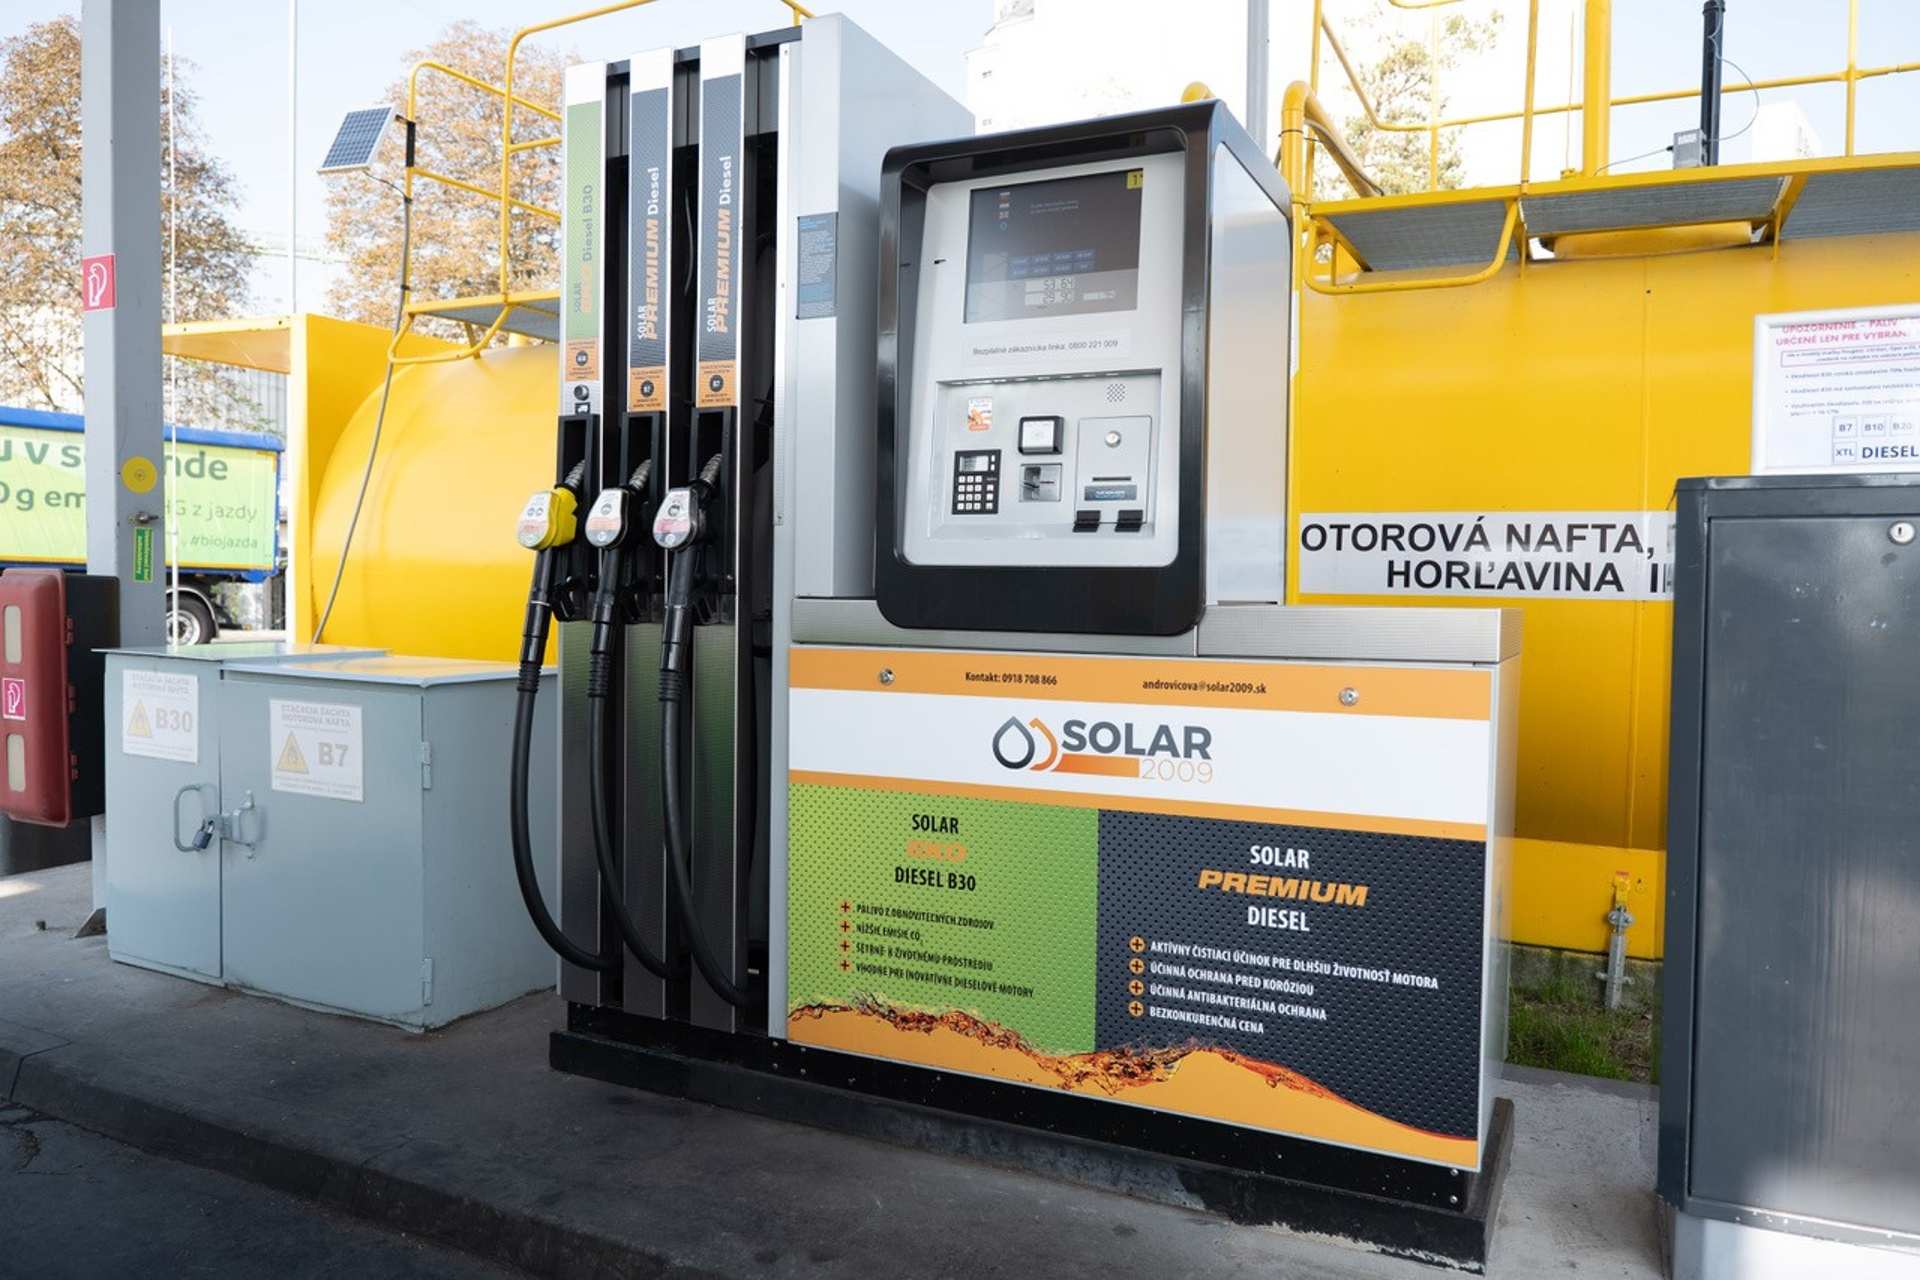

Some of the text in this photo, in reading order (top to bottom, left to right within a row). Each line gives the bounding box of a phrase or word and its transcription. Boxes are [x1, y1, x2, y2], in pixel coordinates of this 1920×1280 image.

[648, 167, 659, 215] Diesel
[719, 156, 732, 205] Diesel
[1104, 339, 1119, 348] 009
[1820, 334, 1839, 344] LEN
[1841, 332, 1860, 341] PRE
[1862, 445, 1920, 459] DIESEL
[205, 500, 258, 523] jazdy
[190, 535, 258, 550] #biojazda
[1301, 516, 1654, 560] OTOROVÁ NAFTA,
[1386, 559, 1625, 593] HORĽAVINA
[965, 671, 1057, 686] Kontakt: 0918 708 866
[1142, 680, 1267, 694] androvicova@solar2009.sk
[155, 707, 192, 733] B30
[1062, 719, 1212, 761] SOLAR
[318, 741, 349, 767] B7
[1141, 758, 1213, 784] 2009
[911, 813, 959, 834] SOLAR
[1250, 844, 1310, 870] SOLAR
[894, 866, 977, 892] DIESEL B30
[1197, 868, 1370, 908] PREMIUM
[856, 903, 885, 917] PALIVO
[1247, 905, 1311, 932] DIESEL
[1150, 940, 1440, 990] AKTÍVNY ČISTIACI ÚČINOK PRE DLHŠIU ŽIVOTNOSŤ MOTORA
[999, 984, 1034, 998] MOTORY
[1149, 961, 1315, 997] ÚČINNÁ OCHRANA PRED KORÓZIOU
[1149, 982, 1328, 1021] ÚČINNÁ ANTIBAKTERIÁLNA OCHRANA
[1149, 1006, 1265, 1035] BEZKONKURENČNÁ CENA
